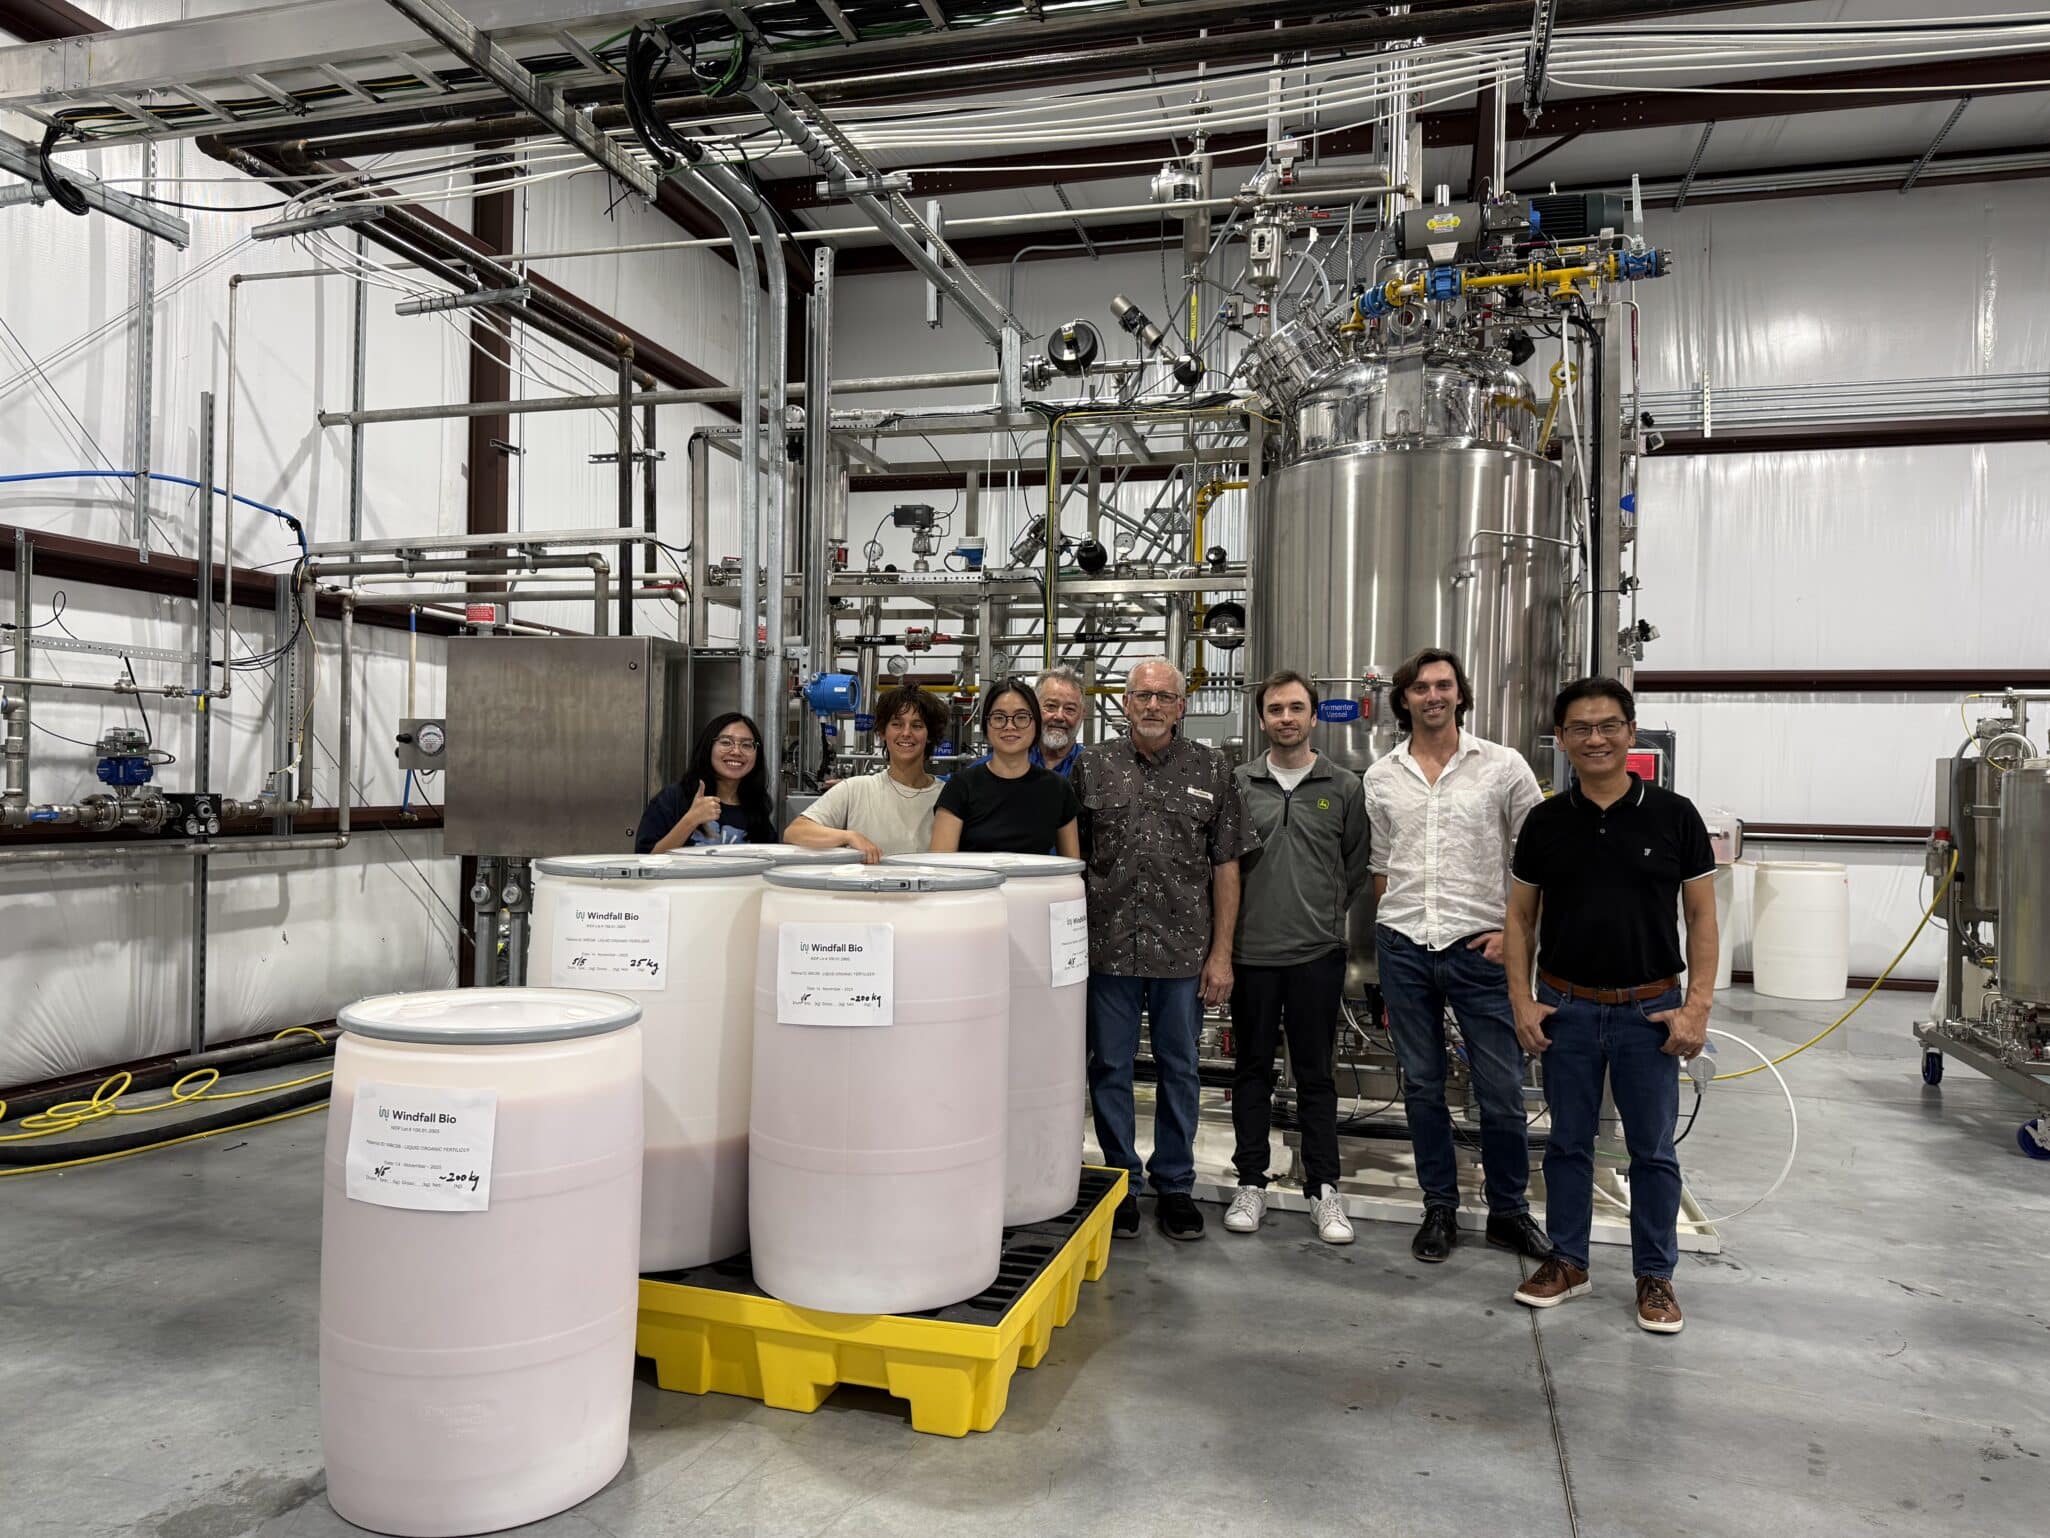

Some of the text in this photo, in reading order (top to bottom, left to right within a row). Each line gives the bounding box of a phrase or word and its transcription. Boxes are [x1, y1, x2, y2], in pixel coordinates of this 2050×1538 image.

[587, 911, 639, 921] Windfall Bio
[811, 943, 863, 953] Windfall Bio
[392, 1109, 457, 1125] Windfall Bio
